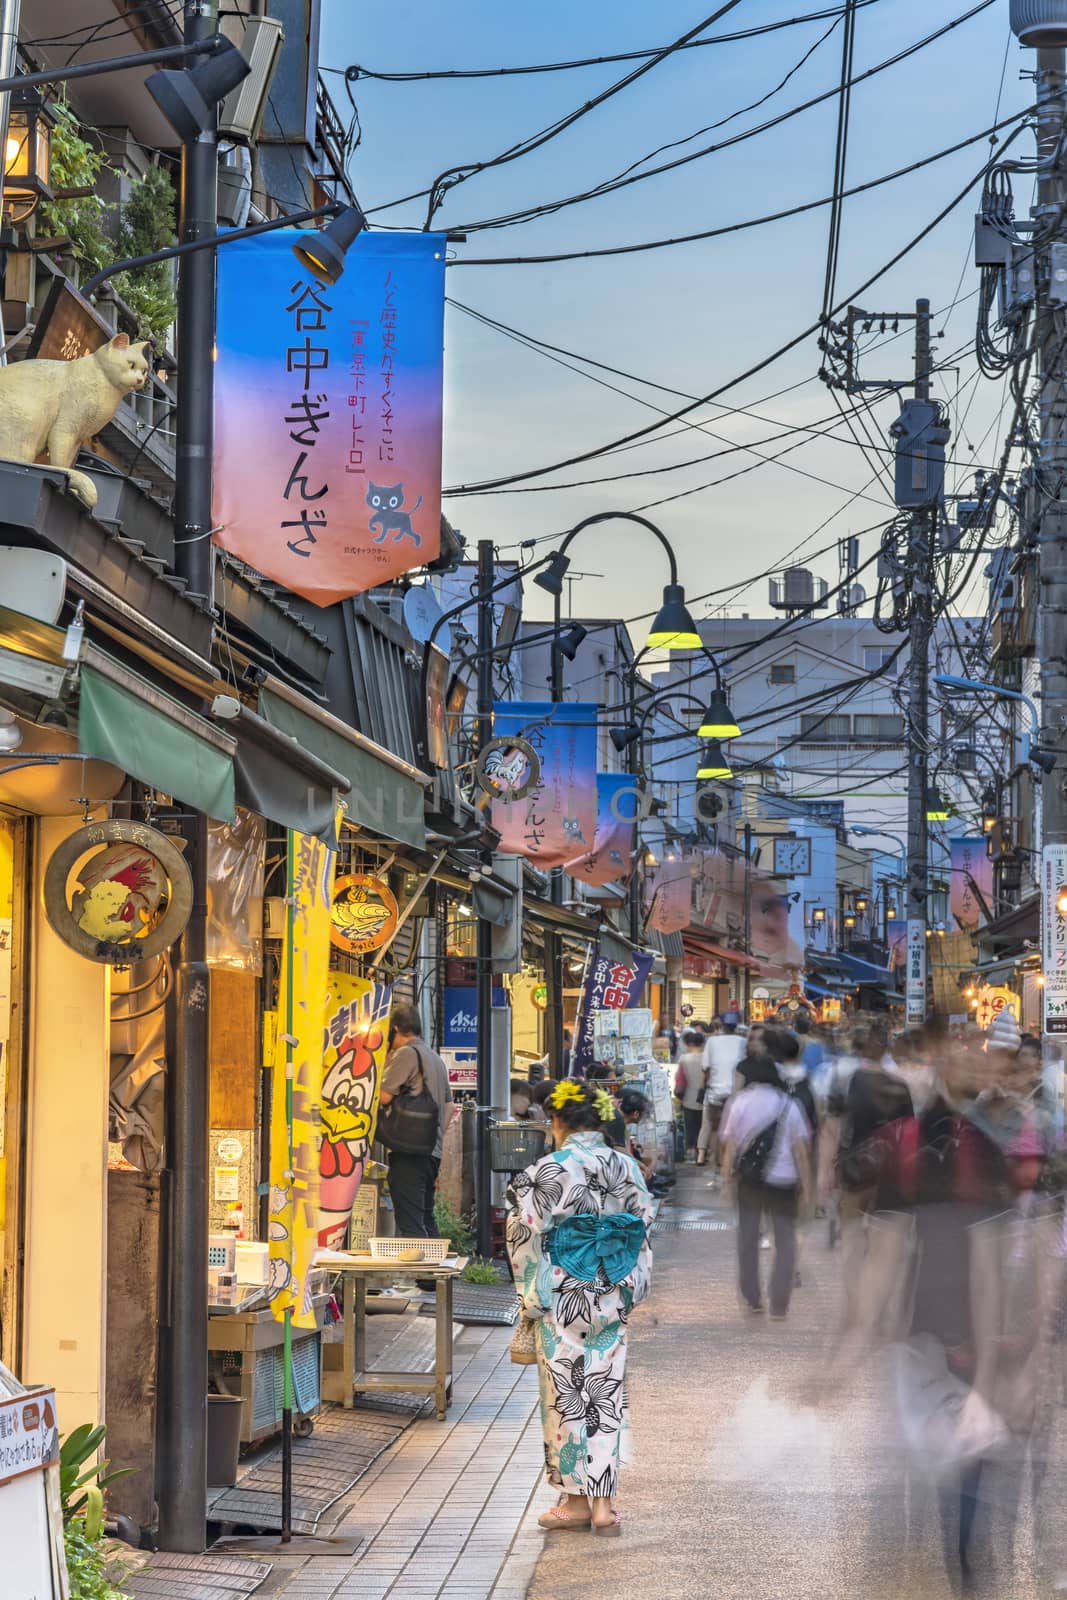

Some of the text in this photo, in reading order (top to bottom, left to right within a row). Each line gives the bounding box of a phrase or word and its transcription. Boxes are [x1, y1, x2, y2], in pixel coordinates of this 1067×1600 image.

[281, 280, 333, 558] 谷中ぎんざ
